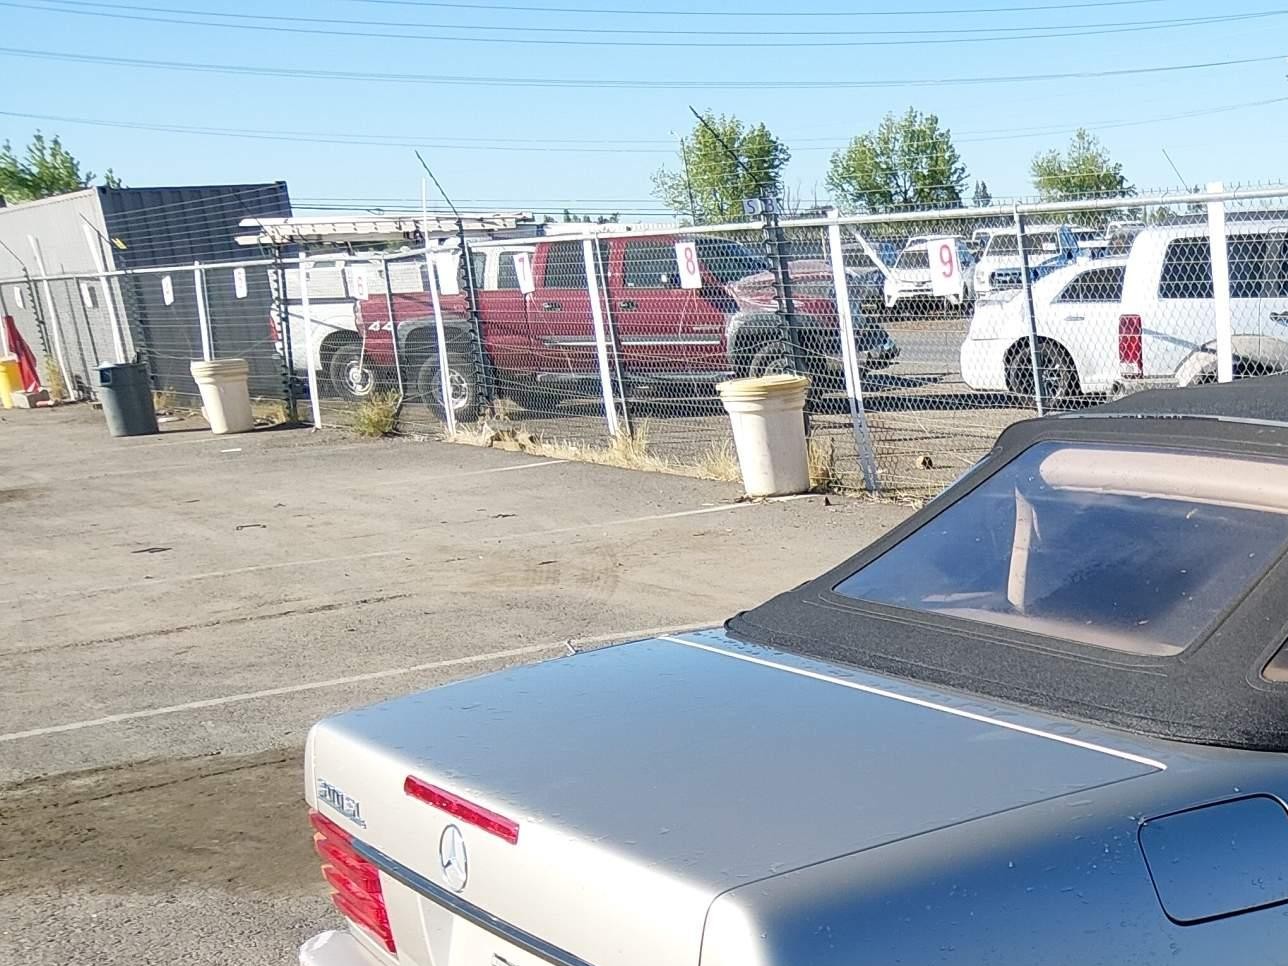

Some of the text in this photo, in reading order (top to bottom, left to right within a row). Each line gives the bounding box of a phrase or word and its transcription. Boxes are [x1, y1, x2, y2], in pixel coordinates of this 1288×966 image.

[518, 256, 527, 281] 7
[684, 246, 696, 276] 8
[939, 244, 954, 278] 9
